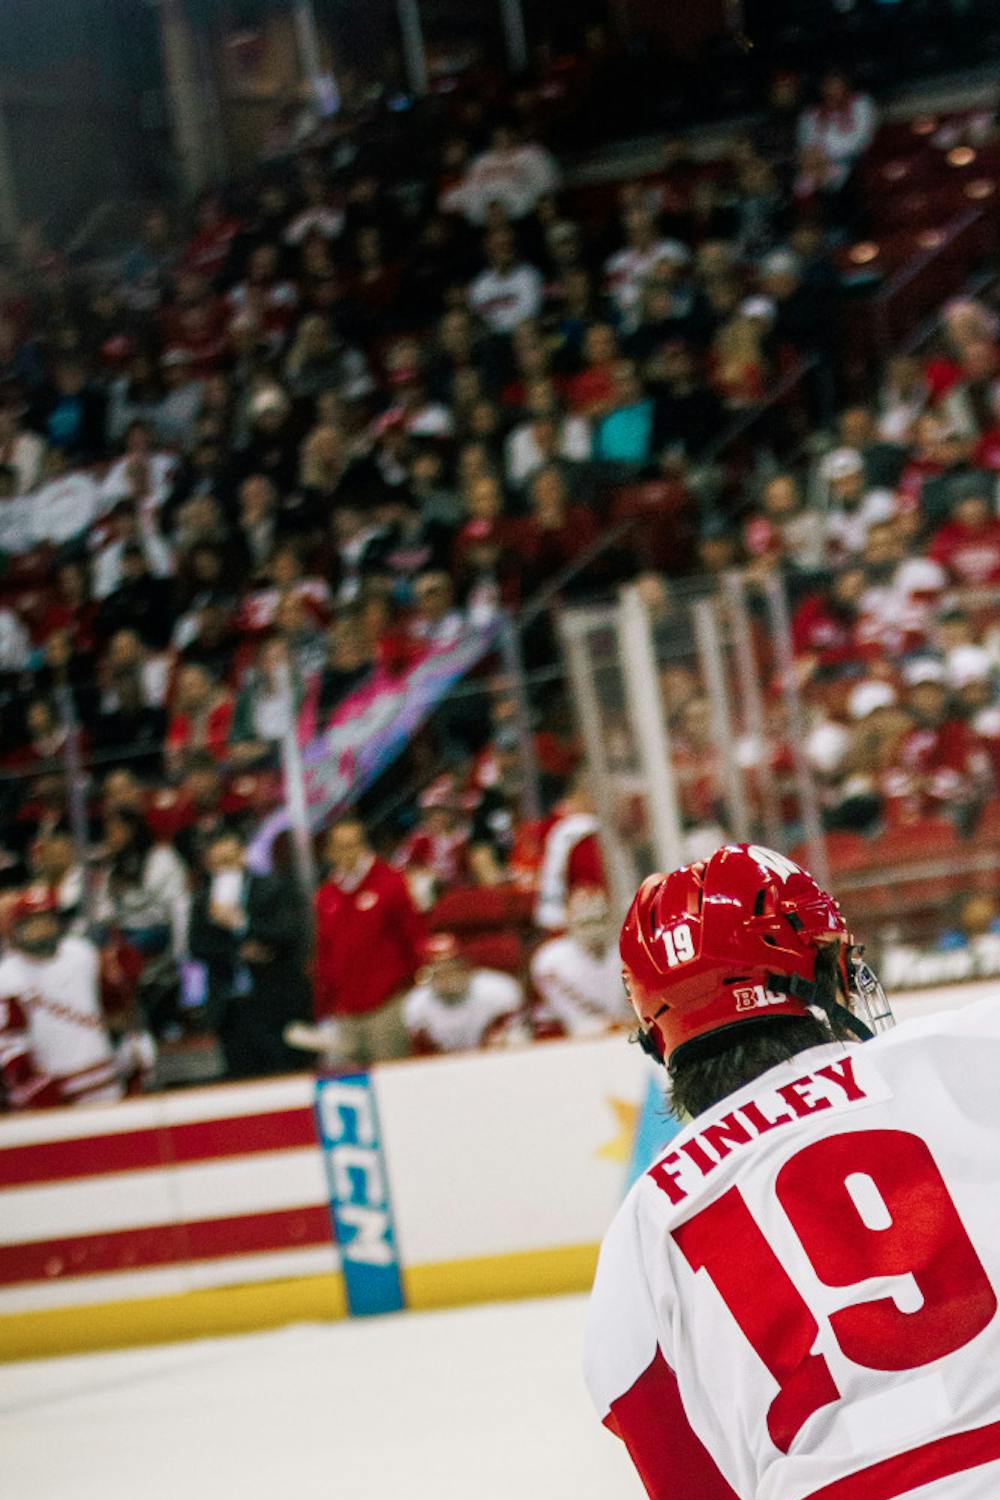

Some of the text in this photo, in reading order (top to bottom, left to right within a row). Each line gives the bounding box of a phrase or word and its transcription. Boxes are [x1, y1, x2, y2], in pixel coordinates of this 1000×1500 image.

[661, 924, 696, 968] 19
[646, 1055, 868, 1206] FINLEY
[669, 1128, 999, 1455] 19
